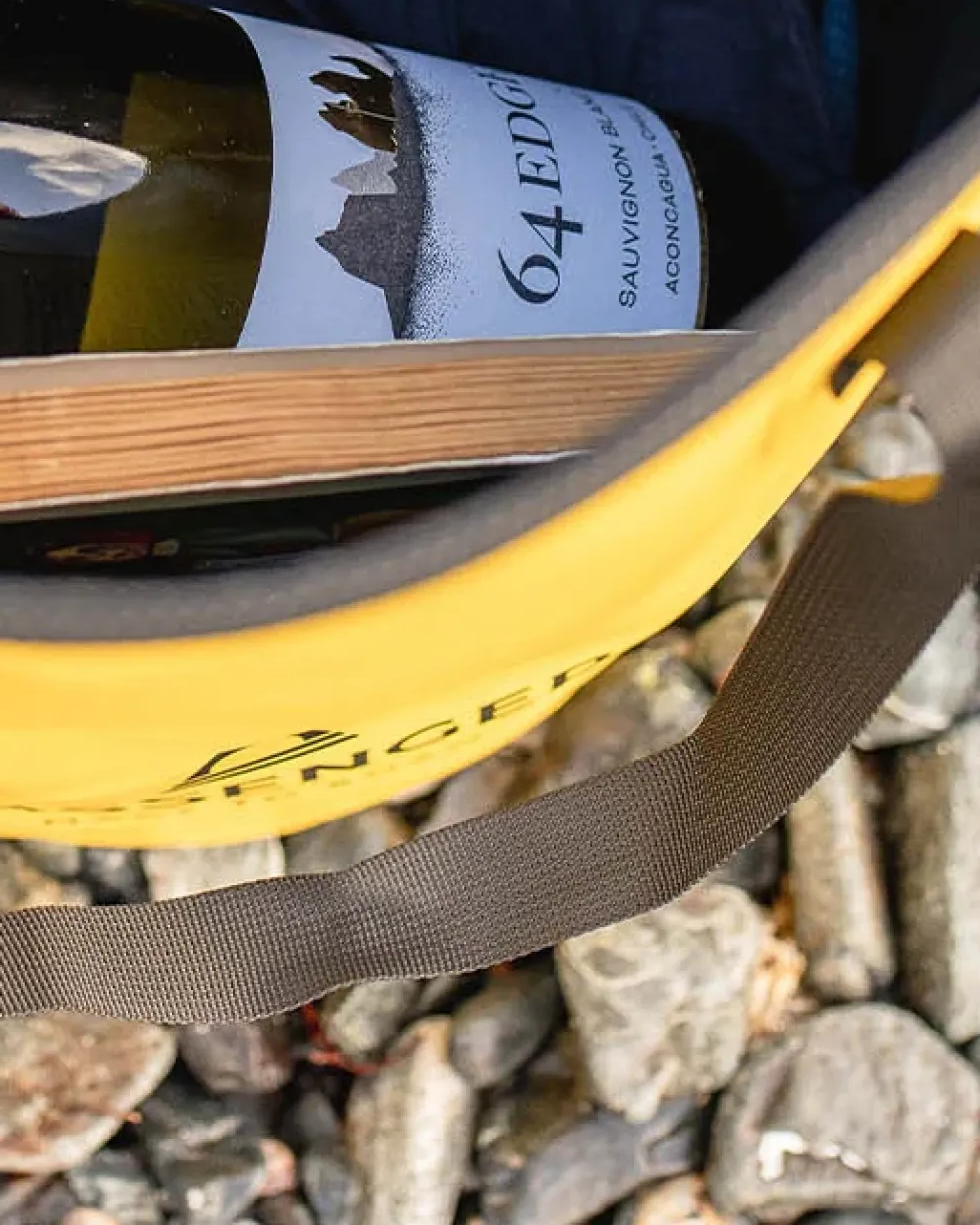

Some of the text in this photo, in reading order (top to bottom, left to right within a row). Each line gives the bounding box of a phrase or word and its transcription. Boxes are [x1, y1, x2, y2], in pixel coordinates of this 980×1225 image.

[568, 90, 620, 138] BLA
[497, 204, 584, 305] 64
[609, 142, 641, 310] SAUVIGNON
[651, 151, 681, 295] ACONCAGUA
